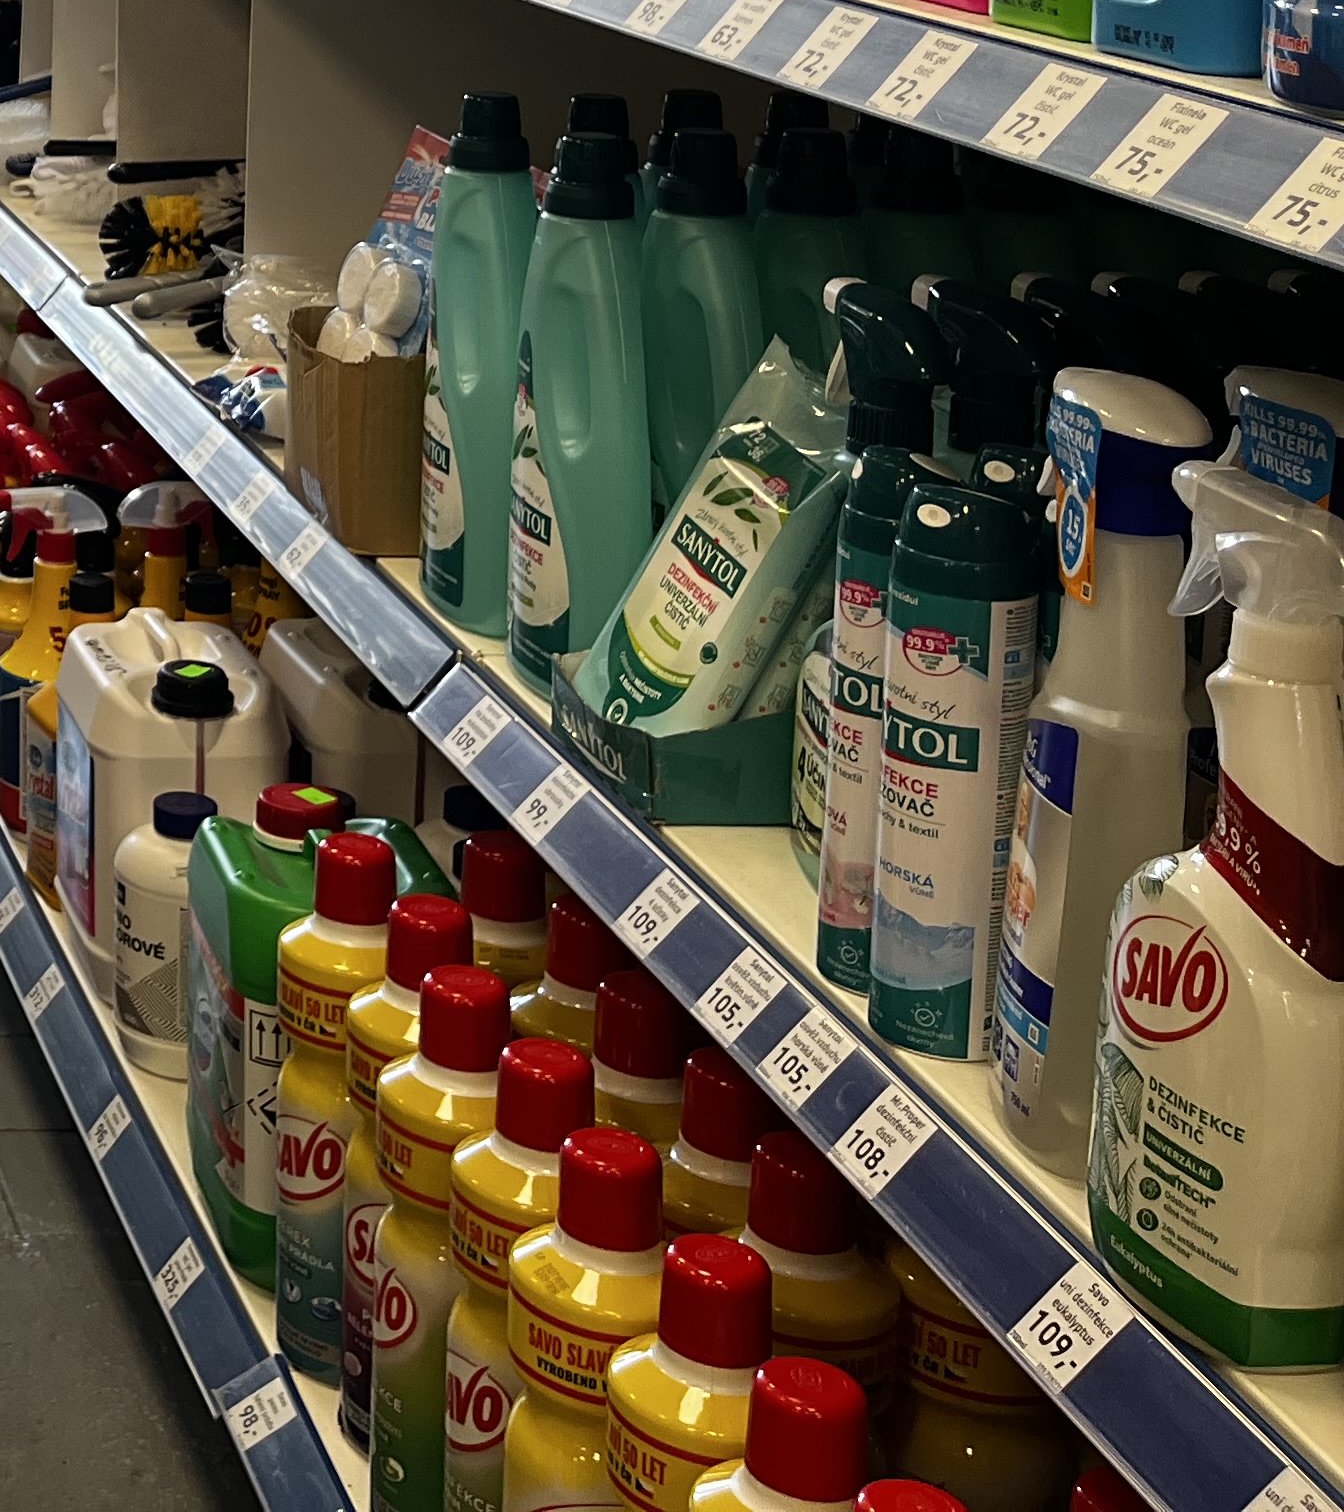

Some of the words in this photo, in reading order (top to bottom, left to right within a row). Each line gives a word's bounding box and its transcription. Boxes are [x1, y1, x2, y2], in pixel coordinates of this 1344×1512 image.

[711, 24, 742, 51] 63,-
[933, 37, 961, 52] Krystal
[795, 49, 828, 79] 72,-
[923, 50, 936, 62] WC
[937, 53, 950, 66] gel
[885, 77, 923, 108] 72,-
[1045, 84, 1058, 97] WC
[1059, 88, 1076, 102] gel
[1056, 70, 1087, 88] Krystal
[1003, 112, 1046, 146] 72,-
[1159, 117, 1176, 132] WC
[1177, 120, 1195, 136] gel
[1170, 101, 1208, 122] Fixinela
[1115, 146, 1162, 183] 75,-
[1308, 181, 1340, 199] citrus
[1271, 194, 1328, 235] 75,-
[1244, 402, 1274, 425] KILLS
[1250, 420, 1328, 462] BACTERIA
[1251, 449, 1312, 486] VIRUSES
[678, 524, 741, 592] SANYTOL
[659, 578, 710, 628] UNIVERZÁLNÍ
[667, 562, 719, 616] DEZINFEKČNÍ
[664, 602, 691, 631] ČISTIČ
[921, 698, 956, 720] styl
[908, 825, 939, 839] textil
[879, 856, 934, 889] HORSKÁ
[627, 905, 659, 945] 109,-
[750, 959, 775, 984] Sanytol
[1122, 925, 1217, 1013] SAVO
[306, 994, 320, 1018] 50
[325, 1003, 346, 1025] LET
[706, 988, 744, 1030] 105,-
[790, 1034, 813, 1059] horská
[818, 1019, 844, 1045] Sanytol
[773, 1046, 812, 1093] 105,-
[876, 1104, 918, 1144] dezinfekční
[890, 1094, 927, 1130] Mr.Proper
[1149, 1075, 1246, 1144] DEZINFEKCE
[1157, 1100, 1205, 1145] ČISTIČ
[847, 1129, 891, 1180] 108,-
[875, 1127, 897, 1148] čistič
[1146, 1128, 1212, 1181] UNIVERZÁLNÍ
[1111, 1233, 1163, 1288] Eukalyptus
[1059, 1279, 1075, 1299] uni
[1071, 1291, 1114, 1339] dezinfekce
[1088, 1282, 1109, 1308] Savo
[1052, 1297, 1095, 1347] eukalyptus
[528, 1322, 562, 1360] SAVO
[927, 1334, 951, 1360] 50
[955, 1340, 980, 1368] LET
[1028, 1309, 1079, 1371] 109,-
[537, 1355, 598, 1392] VYROBENO
[623, 1447, 638, 1472] 50
[642, 1456, 667, 1486] LET
[1264, 1487, 1282, 1508] uni
